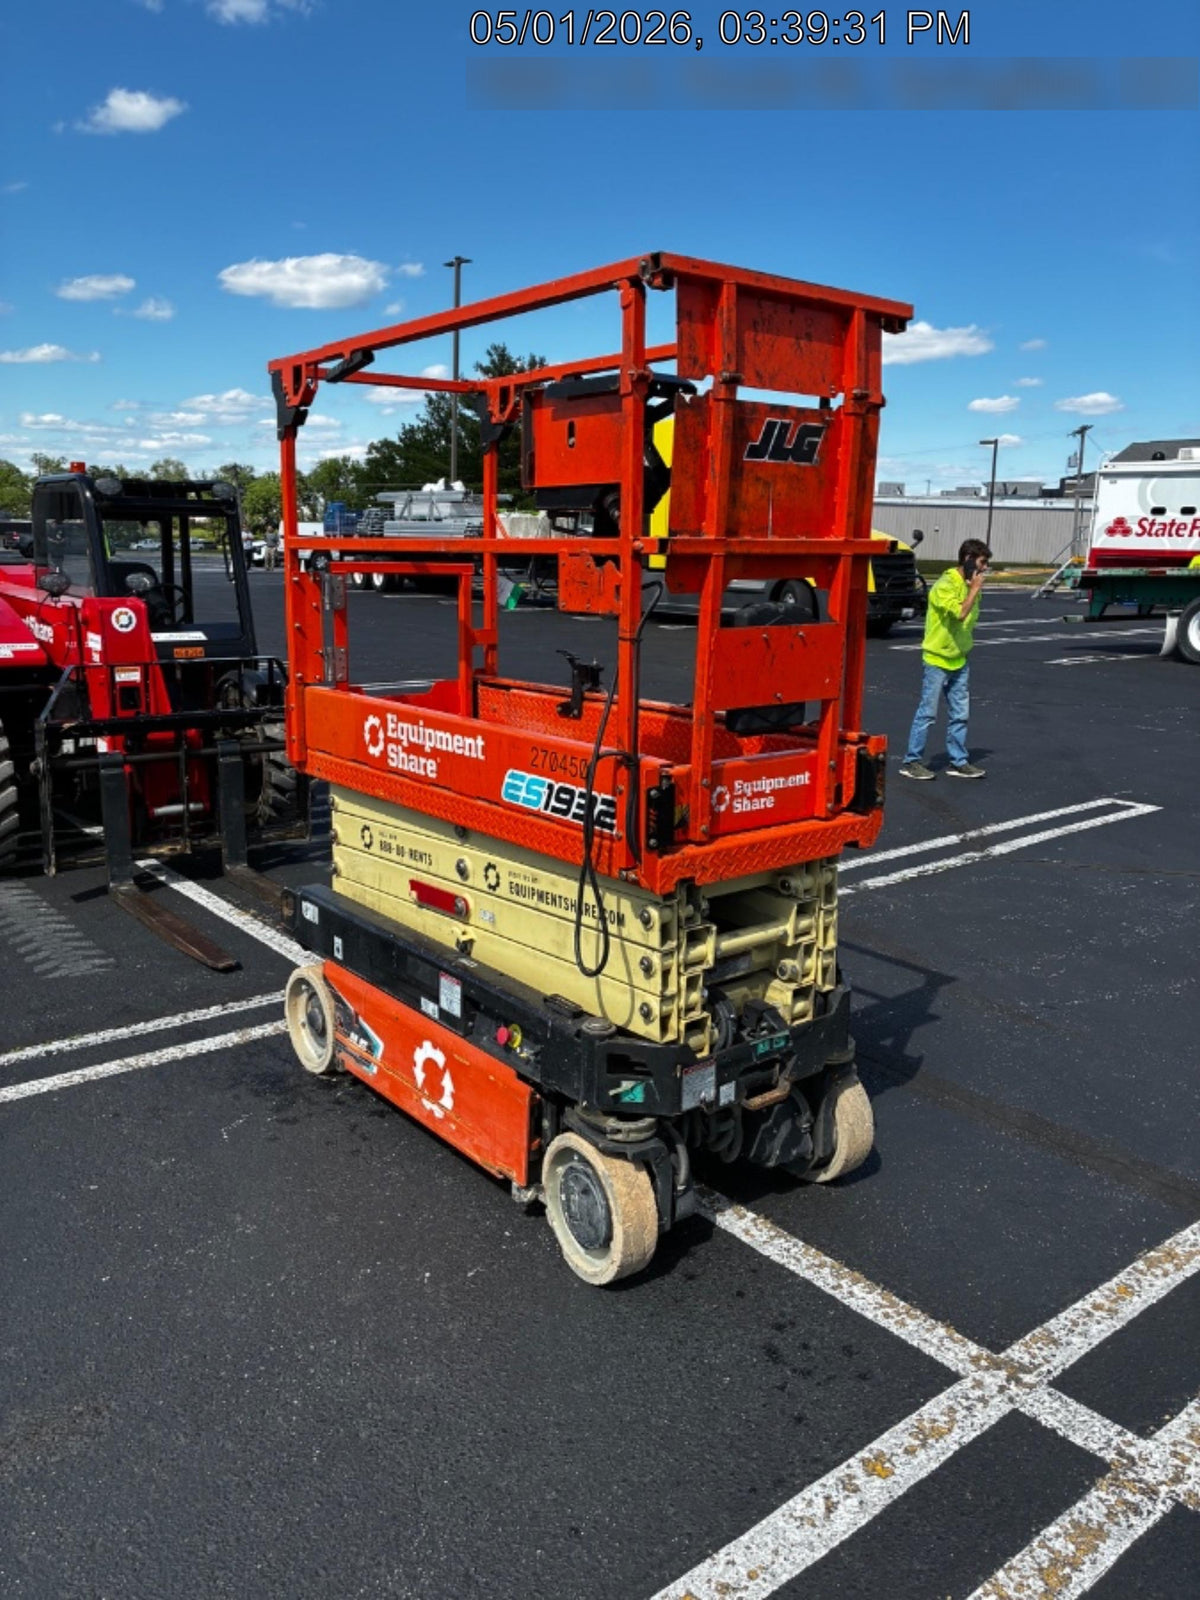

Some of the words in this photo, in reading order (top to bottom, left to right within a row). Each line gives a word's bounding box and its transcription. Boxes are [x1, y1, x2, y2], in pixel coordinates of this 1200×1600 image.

[743, 417, 827, 467] JLG
[386, 713, 486, 761] Equipment
[387, 743, 438, 778] Share
[501, 768, 617, 834] ES1932
[733, 771, 811, 796] Equipment
[732, 796, 775, 814] Share
